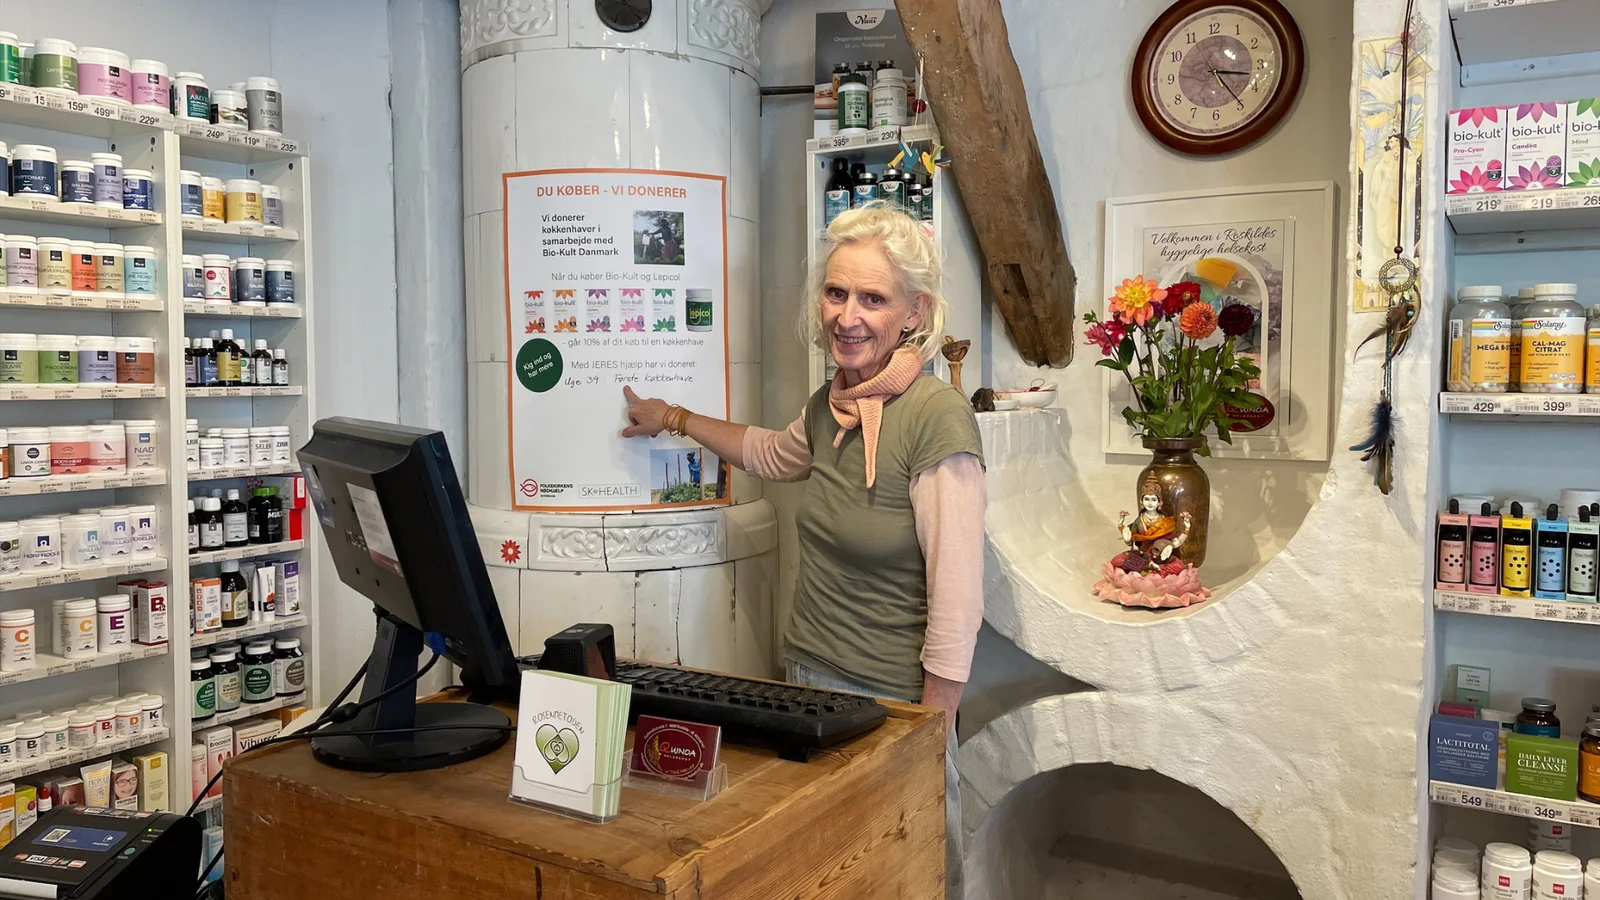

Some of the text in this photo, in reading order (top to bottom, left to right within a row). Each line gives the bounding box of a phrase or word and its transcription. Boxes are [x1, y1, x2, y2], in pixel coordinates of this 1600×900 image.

[1208, 23, 1220, 35] 12
[1236, 24, 1241, 35] 1
[1186, 32, 1197, 44] 11
[1250, 38, 1258, 49] 2
[1171, 51, 1183, 62] 10
[1256, 59, 1265, 70] 3
[1167, 74, 1175, 84] 9
[1174, 94, 1182, 105] 8
[1190, 108, 1198, 119] 7
[1212, 109, 1220, 120] 6
[1453, 128, 1502, 142] bio-kult
[1512, 124, 1561, 137] bio-kult
[537, 186, 553, 197] DU
[557, 184, 600, 196] KØBER
[611, 185, 625, 196] VI
[628, 185, 688, 199] DONERER
[1477, 200, 1498, 211] 219
[541, 213, 585, 223] Vi donerer
[542, 224, 601, 234] køkkenhaver i
[542, 236, 614, 246] samarbejde med
[1151, 232, 1214, 246] Velkommen
[1223, 226, 1278, 243] Roskildes
[542, 248, 620, 257] Bio-Kult Danmark
[1160, 241, 1268, 262] hyggelige helsekost
[551, 271, 681, 283] Når du køber Bio-Kult og Lepicol
[1533, 319, 1567, 332] Solaray
[568, 337, 582, 347] går
[584, 337, 600, 346] 10%
[603, 337, 610, 345] af
[612, 337, 622, 345] dit
[625, 337, 640, 345] køb
[663, 337, 704, 345] køkkenhave
[523, 352, 552, 372] Kig ind og
[571, 360, 589, 369] Med
[591, 360, 619, 369] JERES
[620, 359, 643, 370] hjælp
[645, 360, 658, 368] har
[659, 360, 667, 368] vi
[564, 376, 582, 388] Uge
[586, 375, 600, 385] 39
[614, 374, 640, 384] Første
[1473, 402, 1495, 412] 429
[1543, 401, 1565, 411] 399
[598, 486, 638, 497] HEALTH
[80, 620, 93, 632] C
[110, 615, 124, 630] E
[15, 629, 29, 643] C
[532, 709, 585, 735] ROSENMETODEN
[660, 741, 697, 758] QUINOA
[1437, 738, 1491, 752] LACTITOTAL
[1518, 752, 1567, 765] DAILY LIVER
[1517, 759, 1568, 773] CLEANSE
[1461, 794, 1482, 806] 549
[1534, 806, 1556, 819] 349
